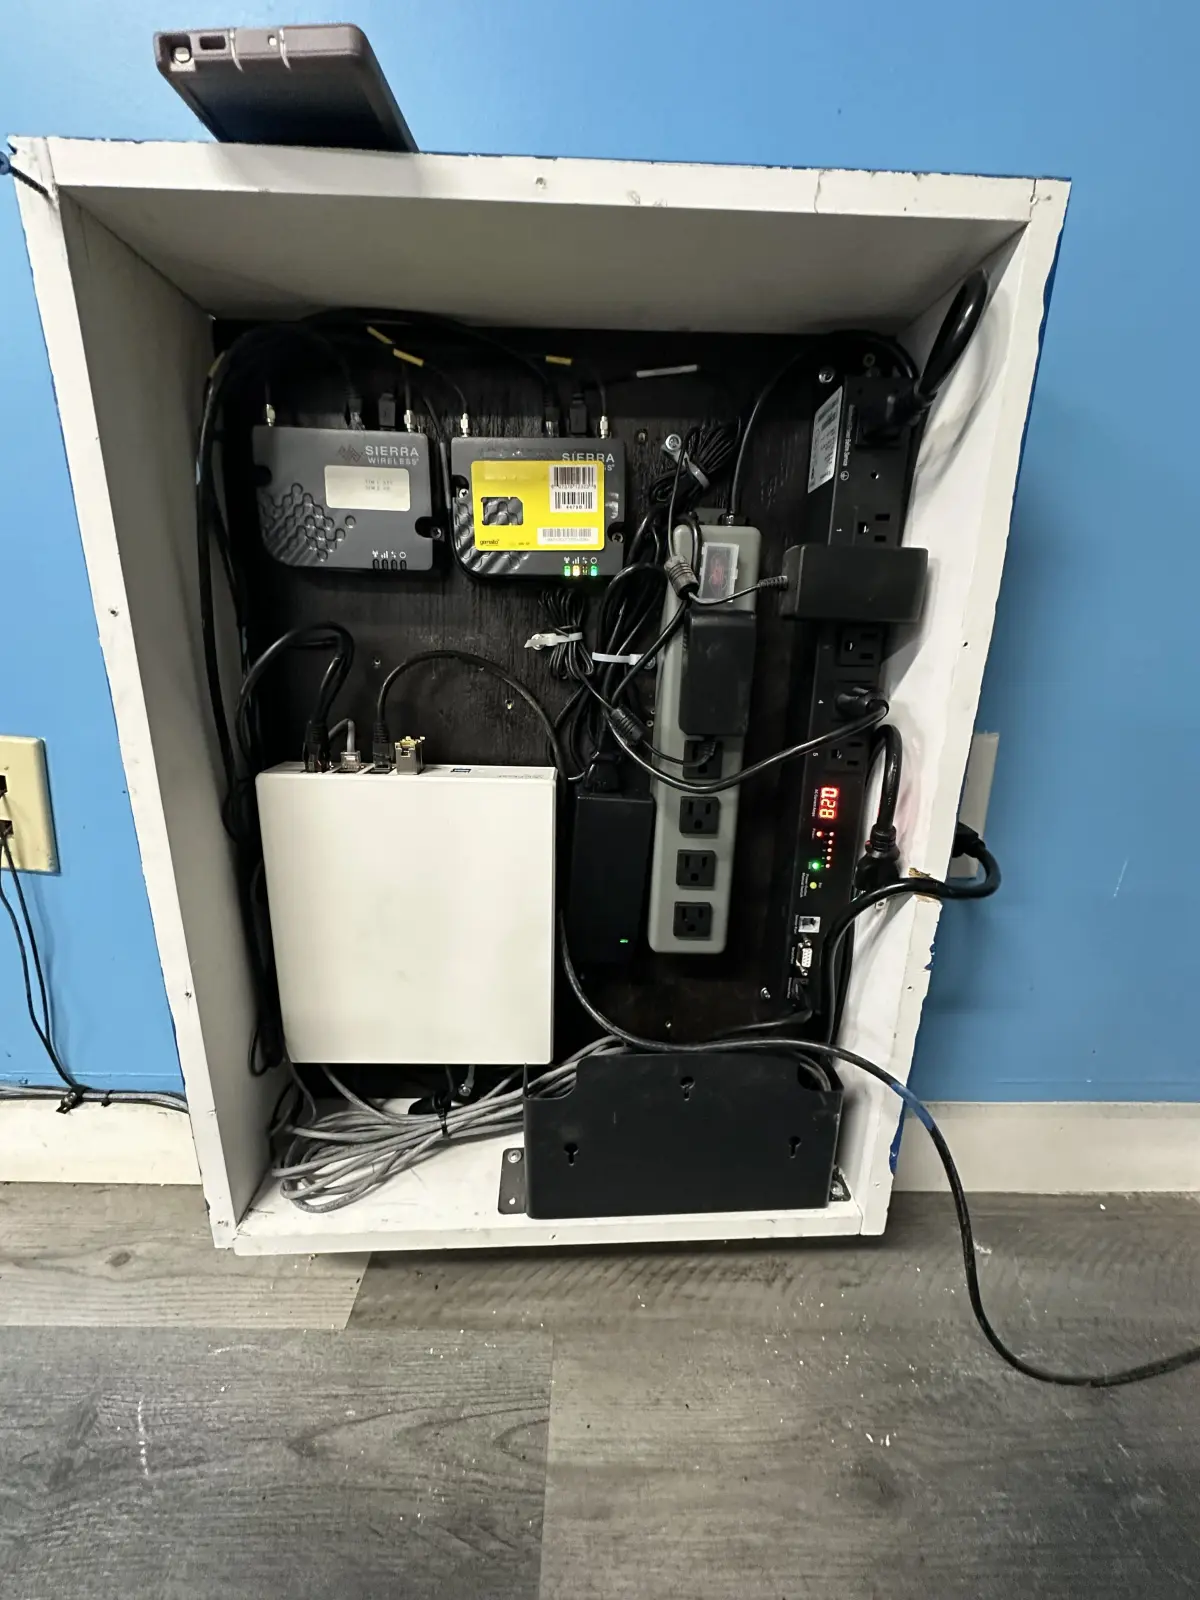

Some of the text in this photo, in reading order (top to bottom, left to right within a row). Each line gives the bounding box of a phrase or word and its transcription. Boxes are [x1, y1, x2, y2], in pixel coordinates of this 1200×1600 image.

[365, 445, 420, 457] SIERRA
[368, 457, 417, 466] WIRELESS
[562, 453, 615, 463] SIERRA
